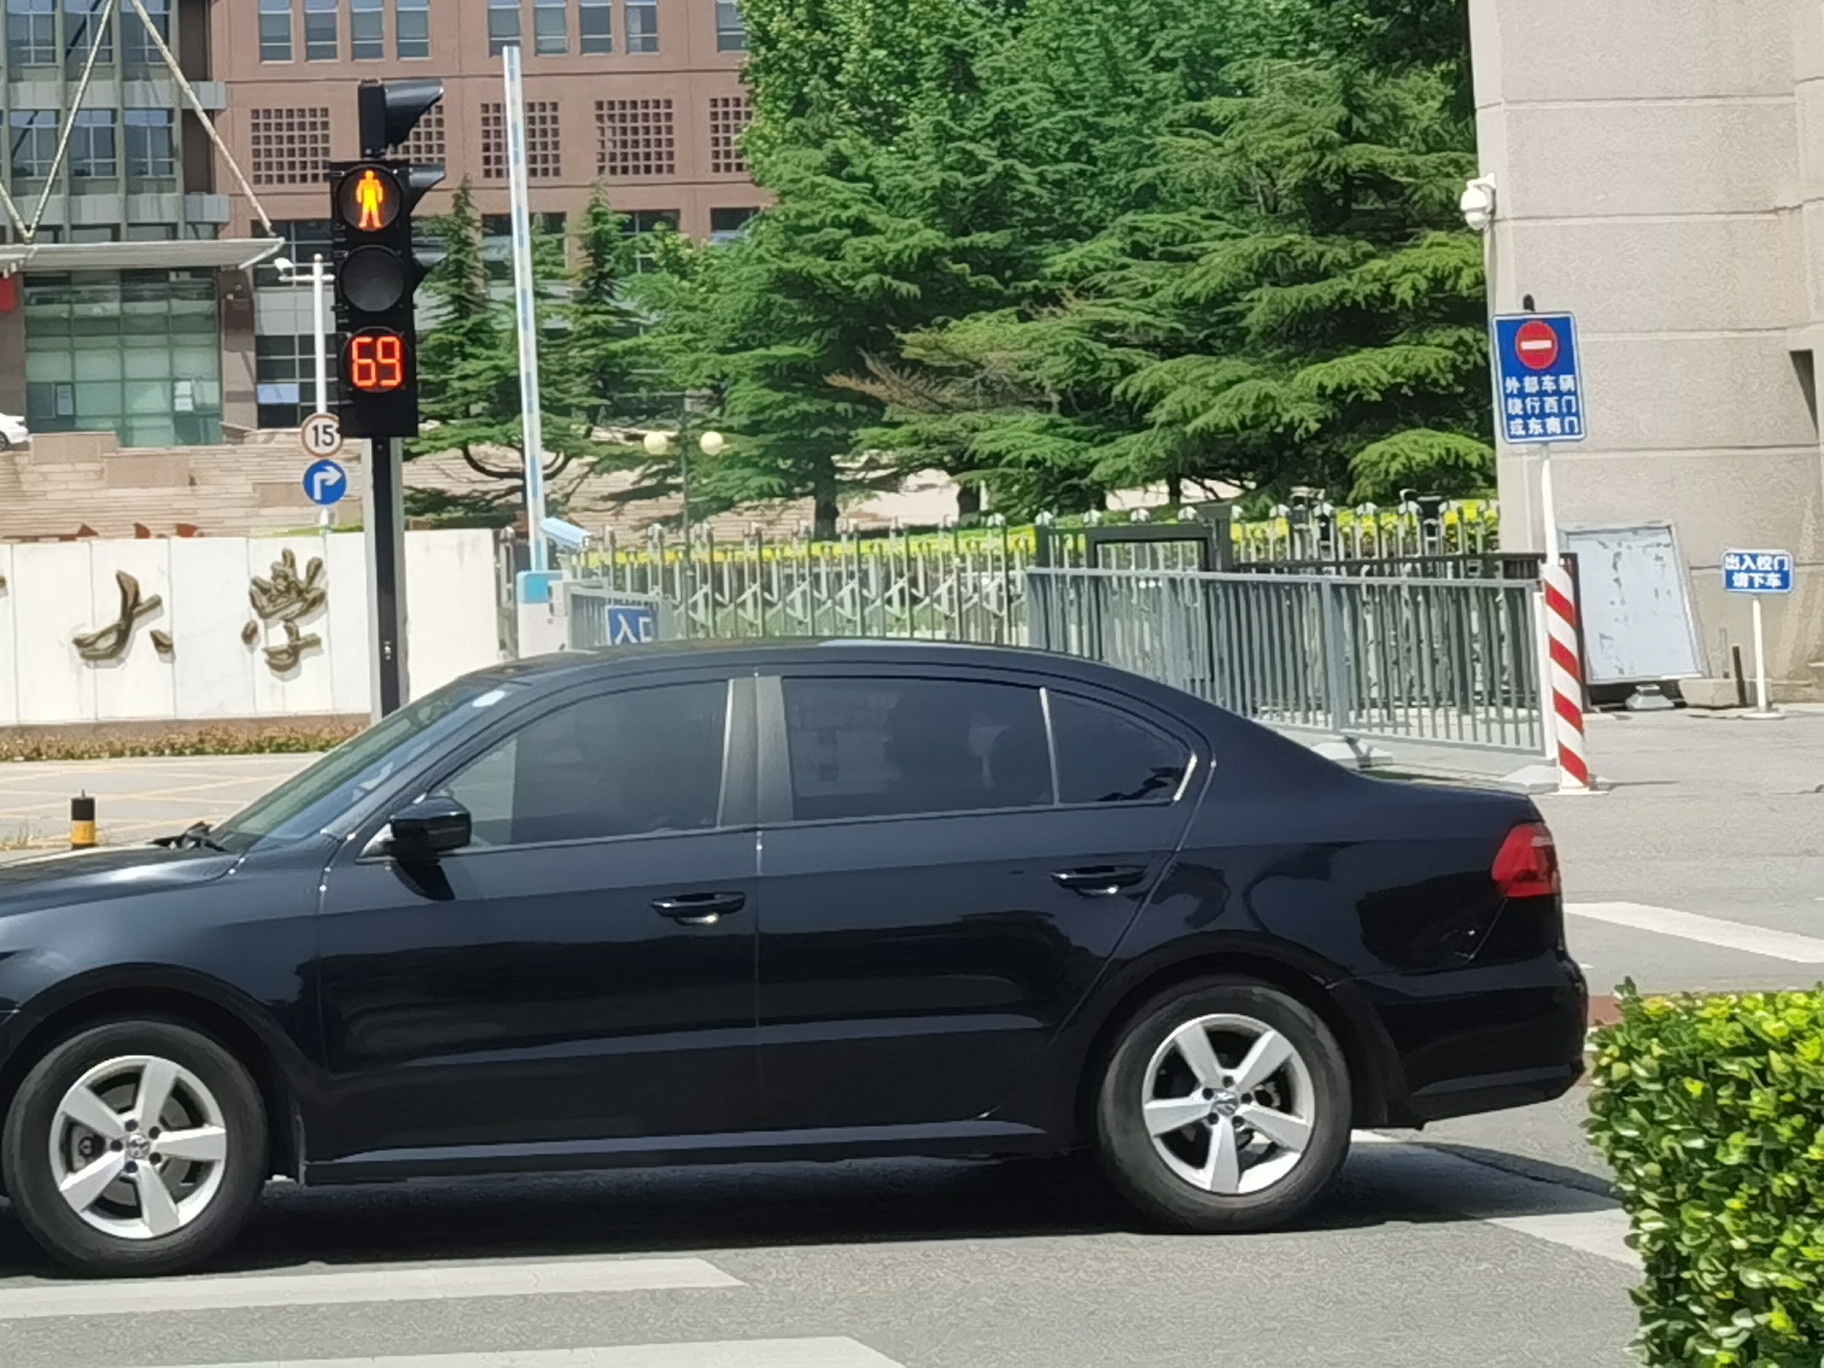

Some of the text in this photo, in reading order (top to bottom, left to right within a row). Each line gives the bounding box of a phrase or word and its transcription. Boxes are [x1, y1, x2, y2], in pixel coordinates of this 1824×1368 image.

[352, 336, 402, 387] 69
[1505, 375, 1575, 394] 外部车辆
[1507, 395, 1577, 415] 绕行西门
[311, 424, 335, 448] 15
[1509, 416, 1579, 436] 或东南门
[1725, 554, 1789, 571] 出入校门
